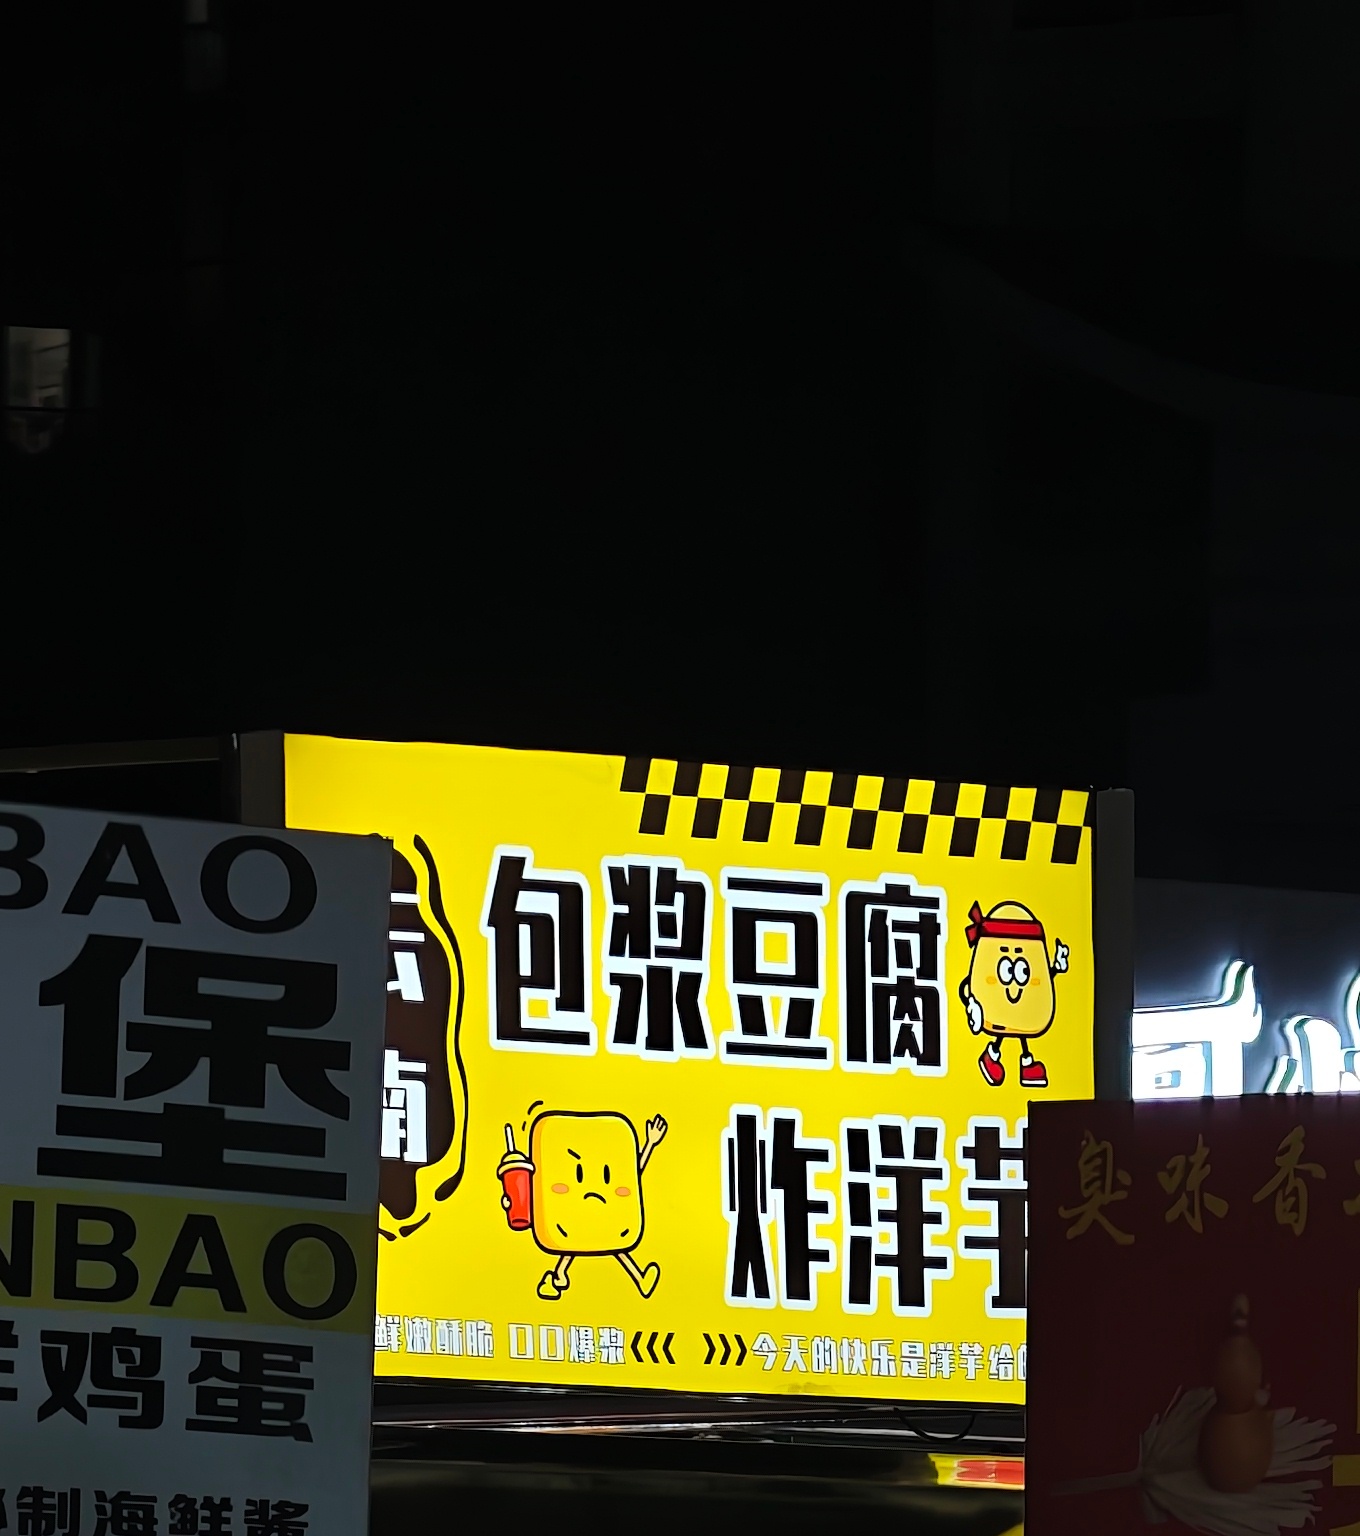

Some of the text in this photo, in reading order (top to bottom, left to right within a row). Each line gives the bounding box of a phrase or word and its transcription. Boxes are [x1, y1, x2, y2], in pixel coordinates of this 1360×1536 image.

[483, 846, 947, 1075] 包浆豆腐
[726, 1104, 1027, 1317] 炸洋芋
